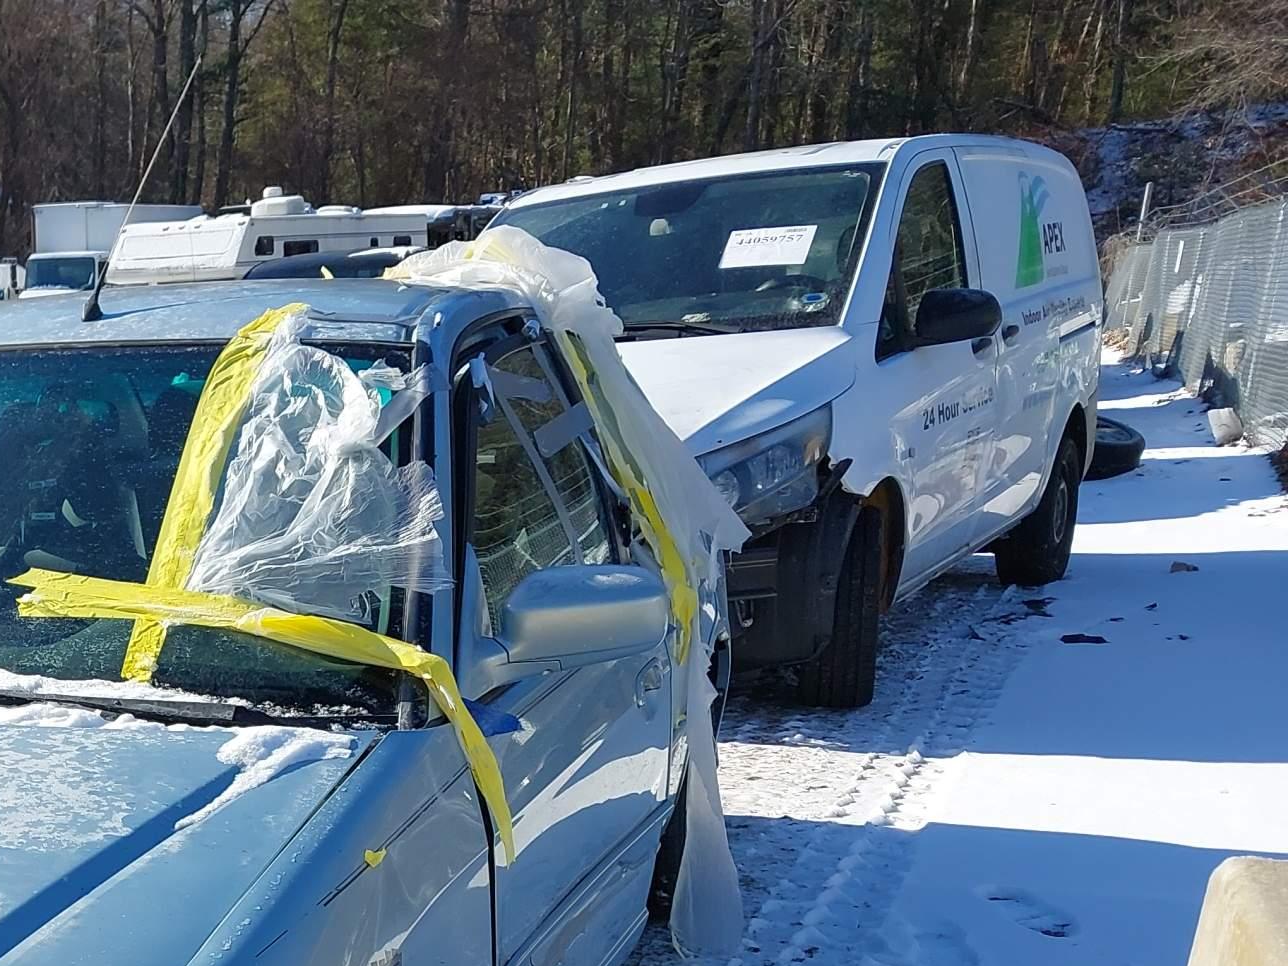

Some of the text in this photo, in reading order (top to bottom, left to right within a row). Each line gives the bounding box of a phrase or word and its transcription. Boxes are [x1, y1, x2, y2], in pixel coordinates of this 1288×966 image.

[1042, 221, 1067, 255] APEX
[1021, 309, 1042, 326] Indoor
[922, 406, 936, 431] 24
[937, 402, 960, 425] Hour
